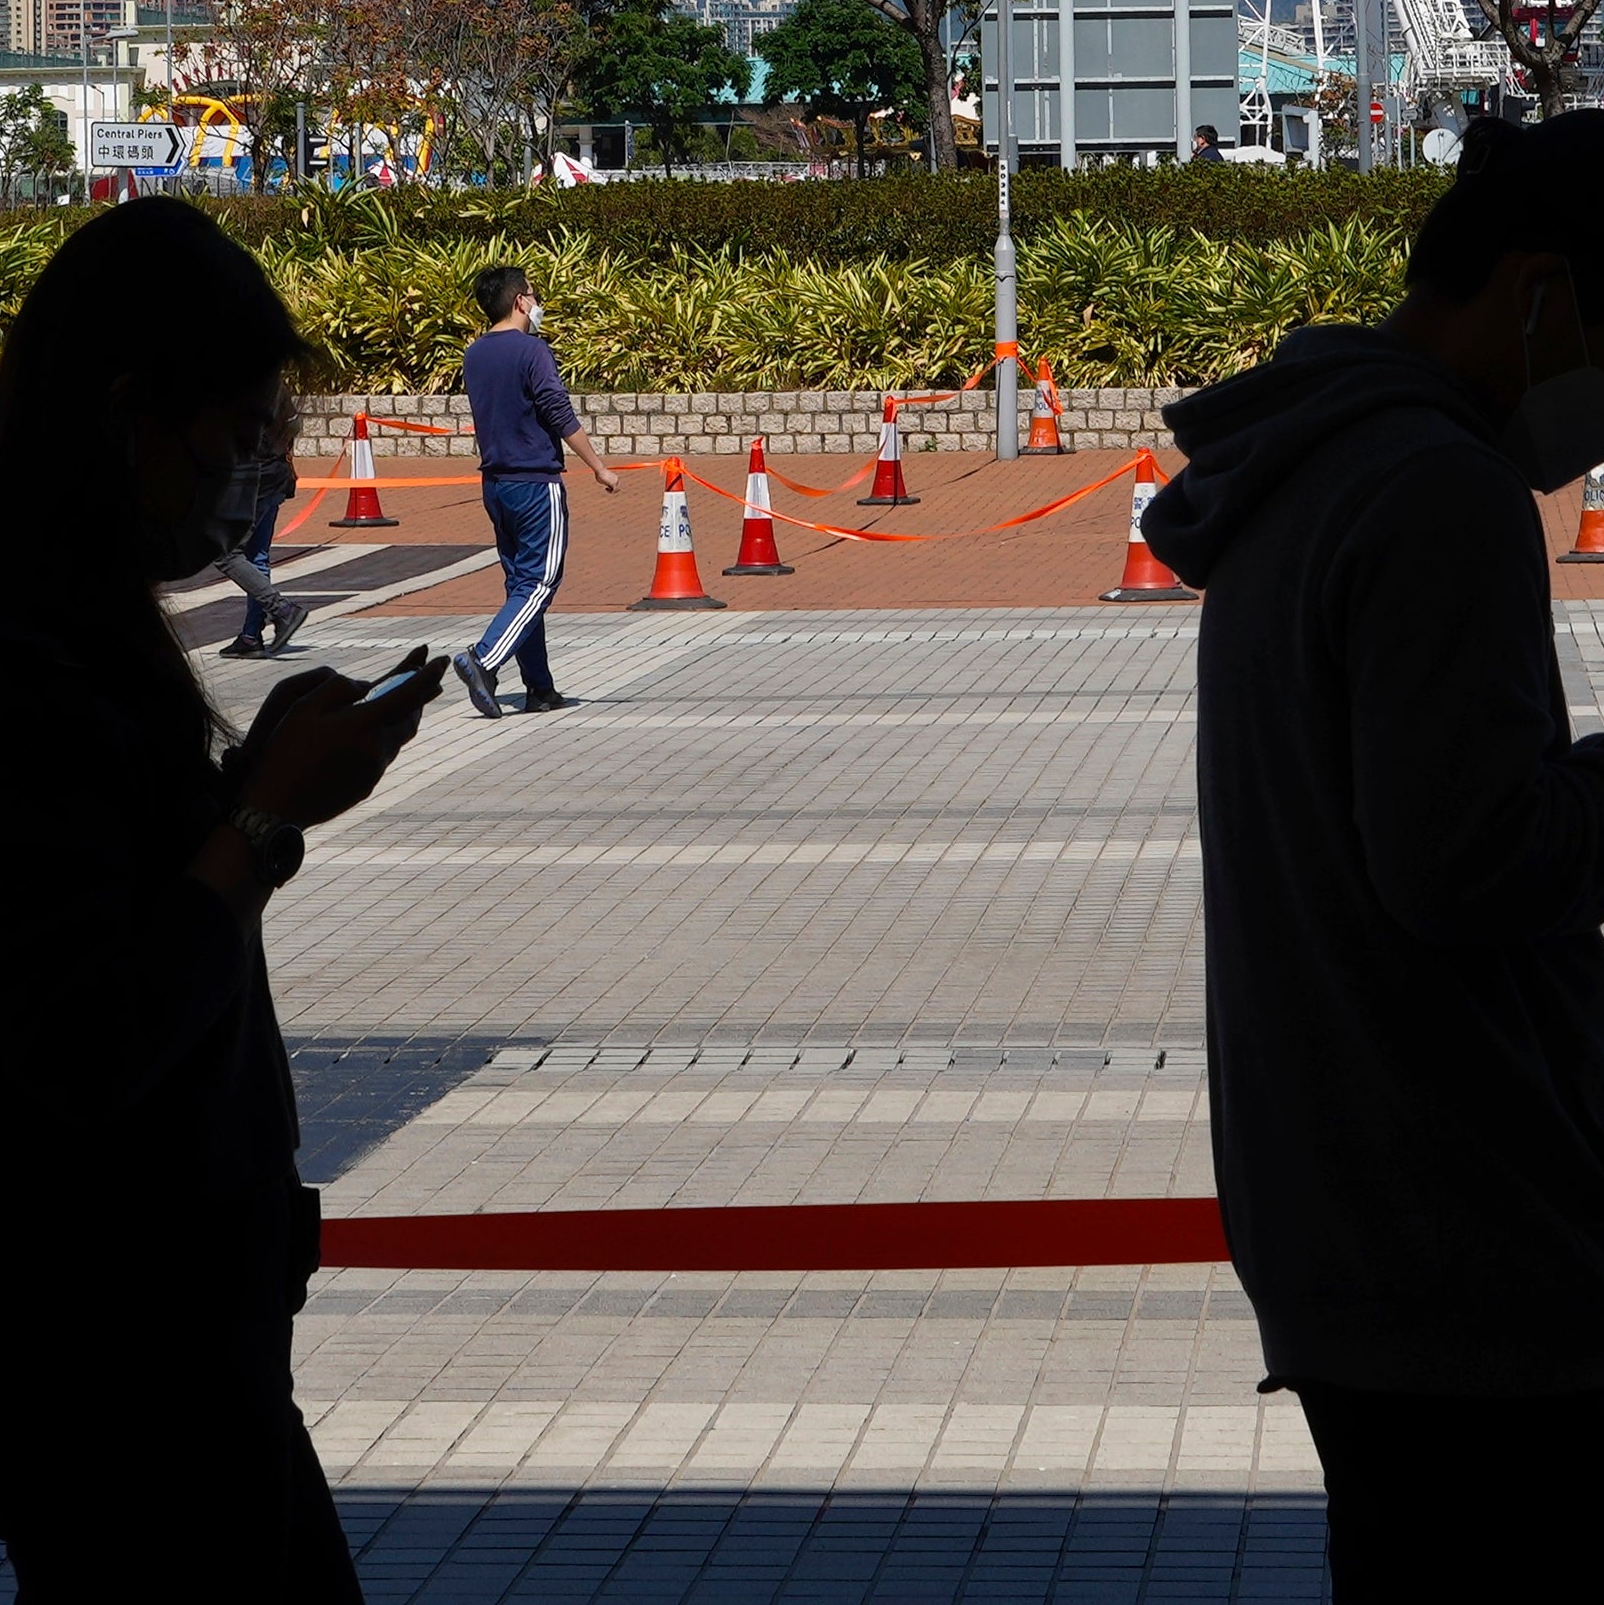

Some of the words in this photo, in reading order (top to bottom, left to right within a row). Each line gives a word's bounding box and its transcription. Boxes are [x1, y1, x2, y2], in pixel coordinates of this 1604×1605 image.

[97, 128, 135, 139] Central
[137, 128, 163, 139] Piers
[98, 144, 154, 160] 中環碼頭
